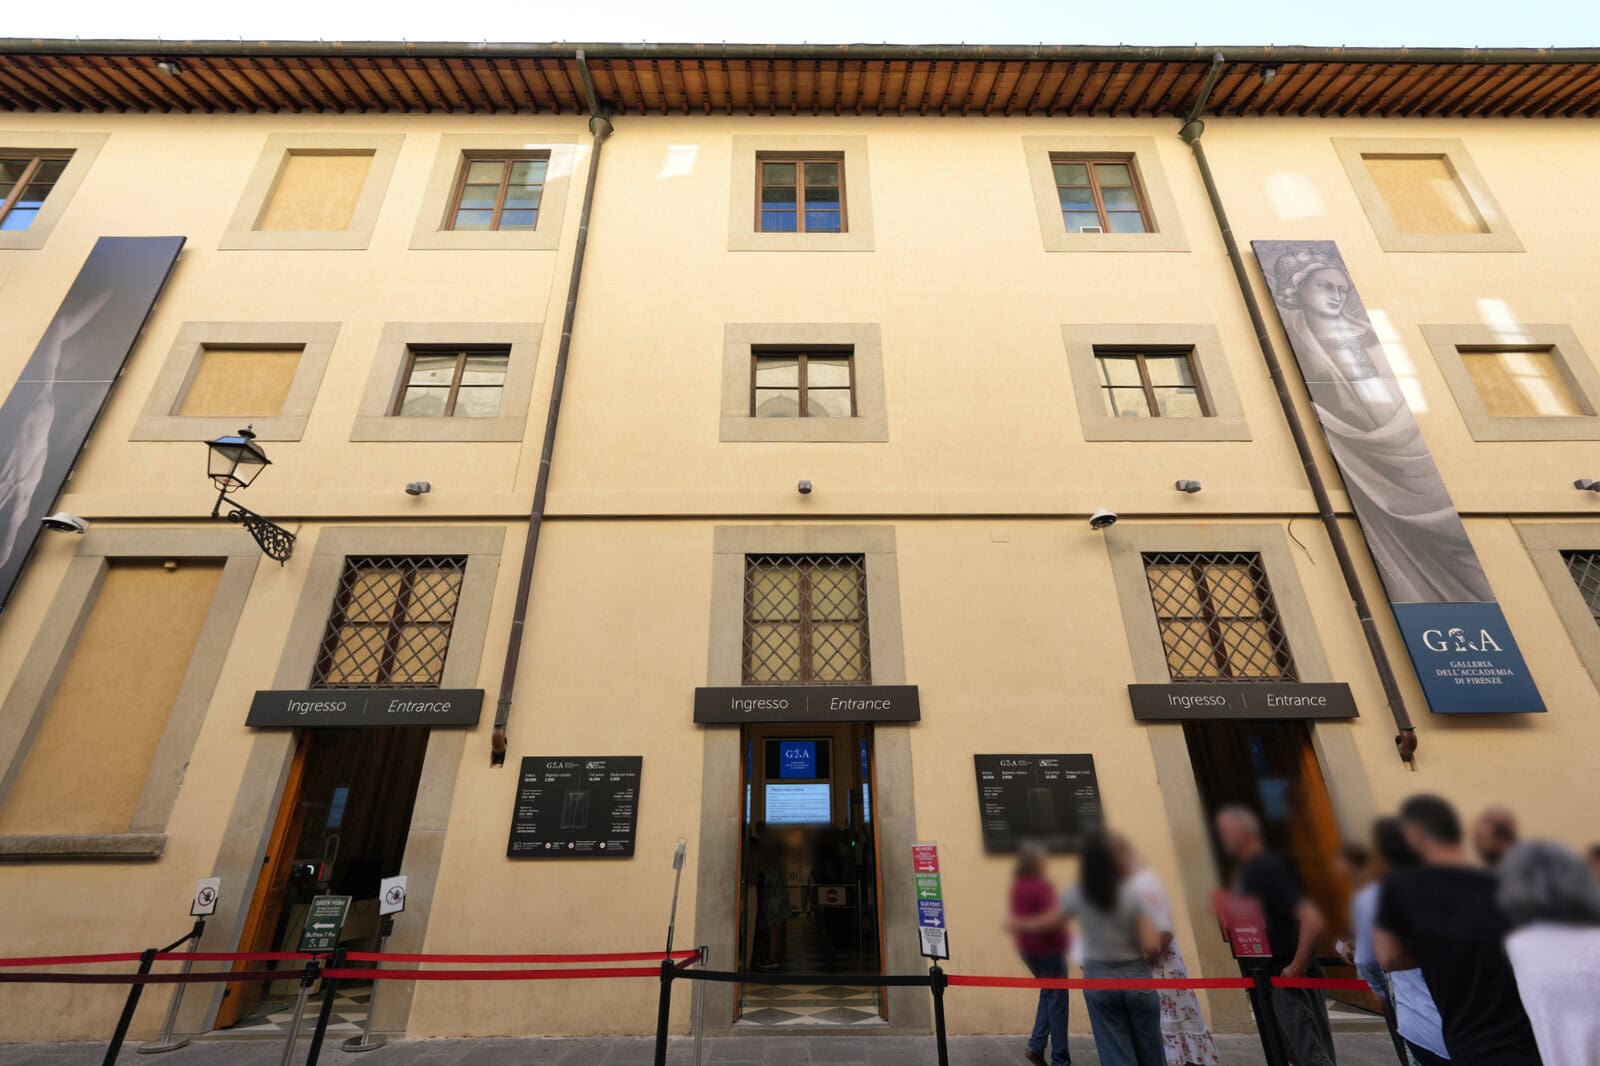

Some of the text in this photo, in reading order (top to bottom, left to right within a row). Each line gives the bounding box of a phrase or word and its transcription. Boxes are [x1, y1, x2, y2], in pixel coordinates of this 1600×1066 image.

[1449, 660, 1493, 668] GALLERIA
[1436, 668, 1514, 677] DELL'ACCADEMIA
[1455, 676, 1504, 685] DI FIRENZE
[287, 698, 452, 715] Ingresso Entrance
[731, 697, 891, 713] Ingresso Entrance
[1167, 693, 1327, 709] Ingresso Entrance
